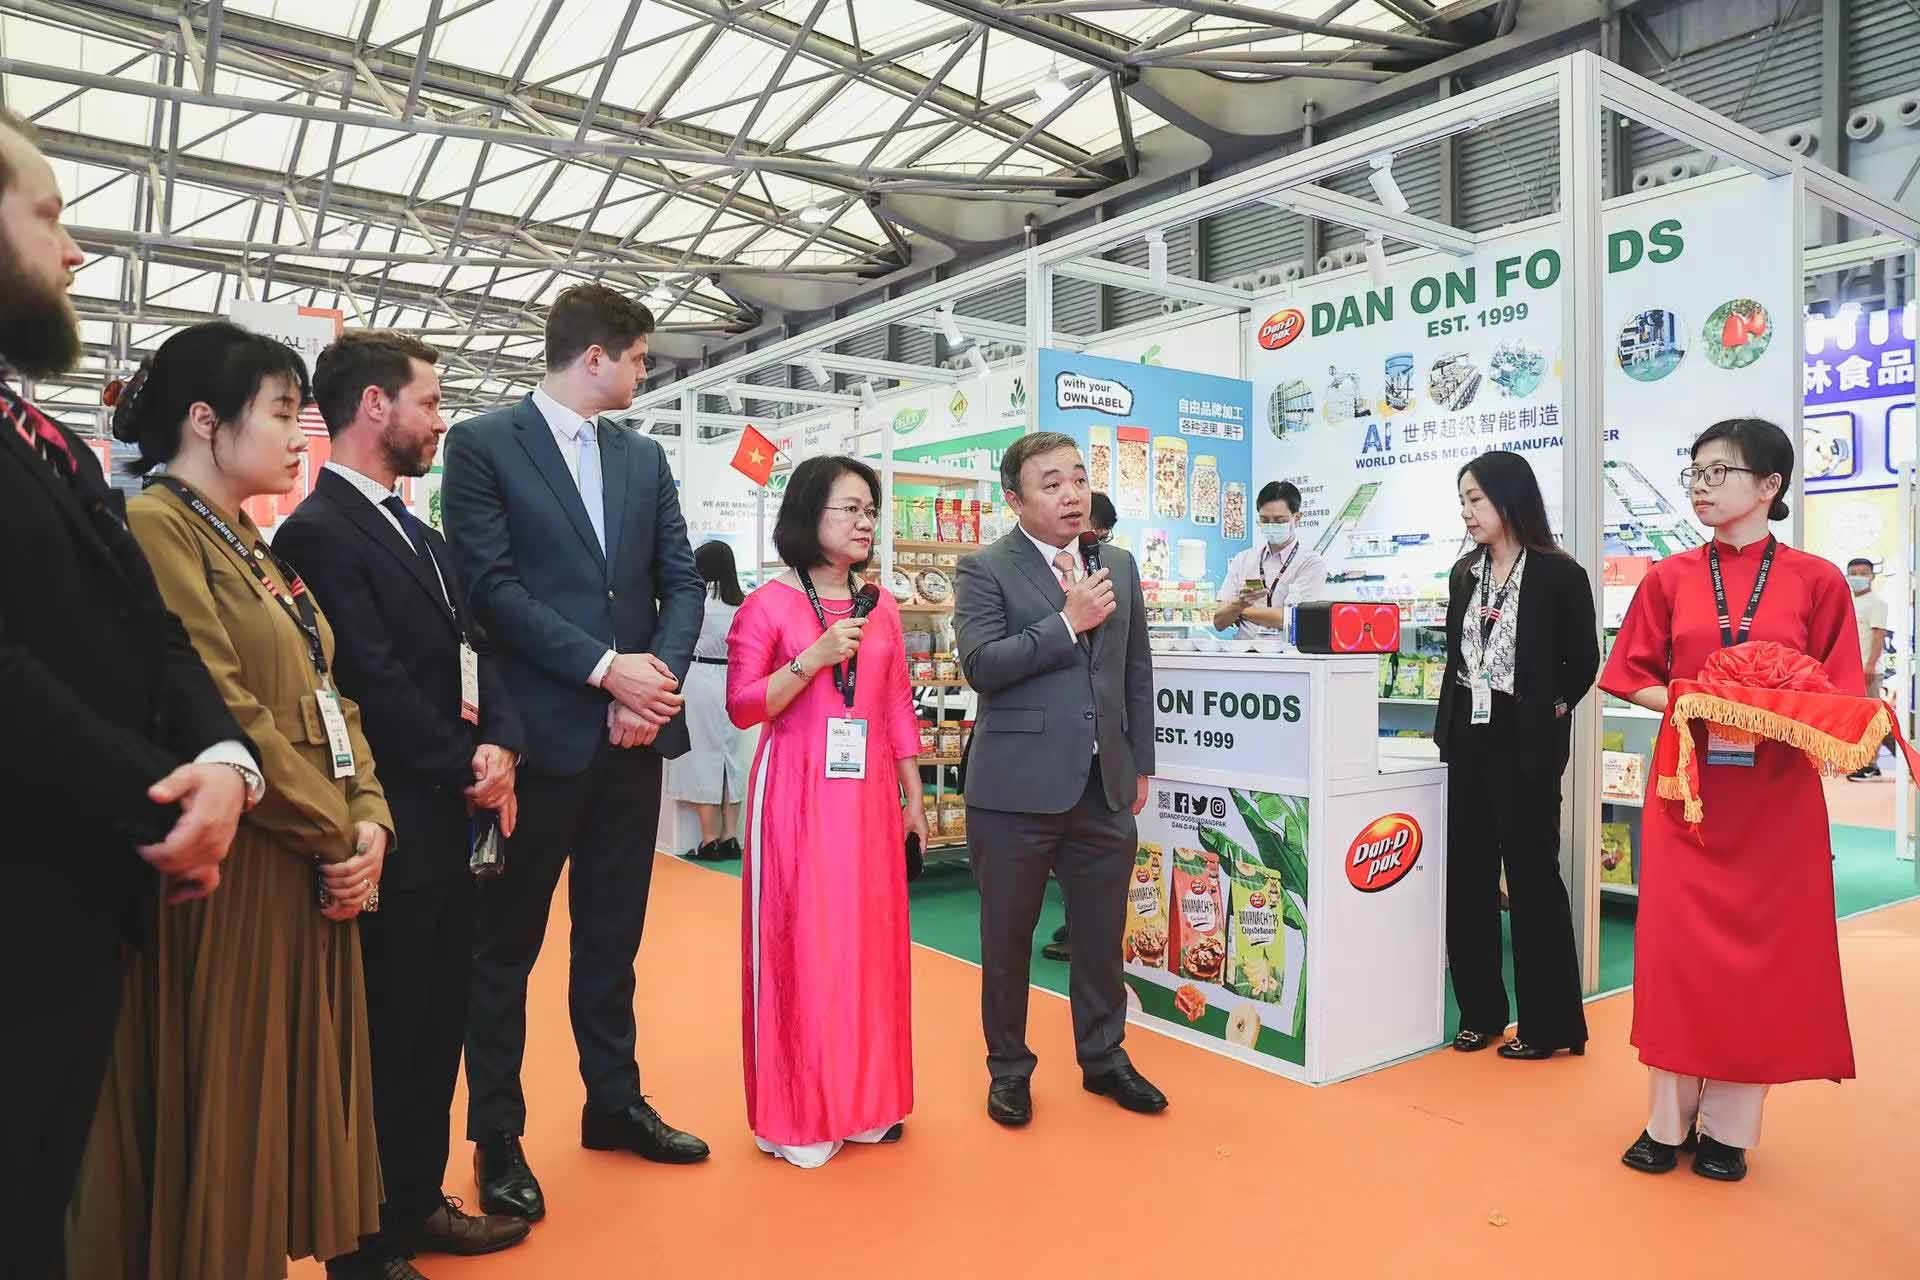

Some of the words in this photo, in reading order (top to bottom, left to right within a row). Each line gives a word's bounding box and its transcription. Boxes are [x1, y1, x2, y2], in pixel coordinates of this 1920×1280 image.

[1311, 285, 1394, 338] DAN
[1410, 265, 1476, 315] ON
[1496, 218, 1684, 298] FODS
[1427, 314, 1470, 338] EST.
[1477, 302, 1530, 331] 1999
[1063, 378, 1086, 390] with
[1089, 382, 1112, 393] your
[1063, 391, 1089, 404] OWN
[1091, 395, 1124, 409] LABEL
[1403, 404, 1560, 444] 世界超级智能制造
[1355, 455, 1396, 470] WORLD
[1400, 450, 1438, 465] CLASS
[1442, 447, 1478, 462] MEGA
[1676, 447, 1692, 456] EN
[191, 500, 210, 516] 2023
[207, 514, 237, 543] Shanghai
[1156, 688, 1194, 715] ON
[1203, 691, 1301, 723] FOODS
[1155, 727, 1188, 745] EST.
[1193, 730, 1234, 750] 1999
[1366, 849, 1402, 884] pak
